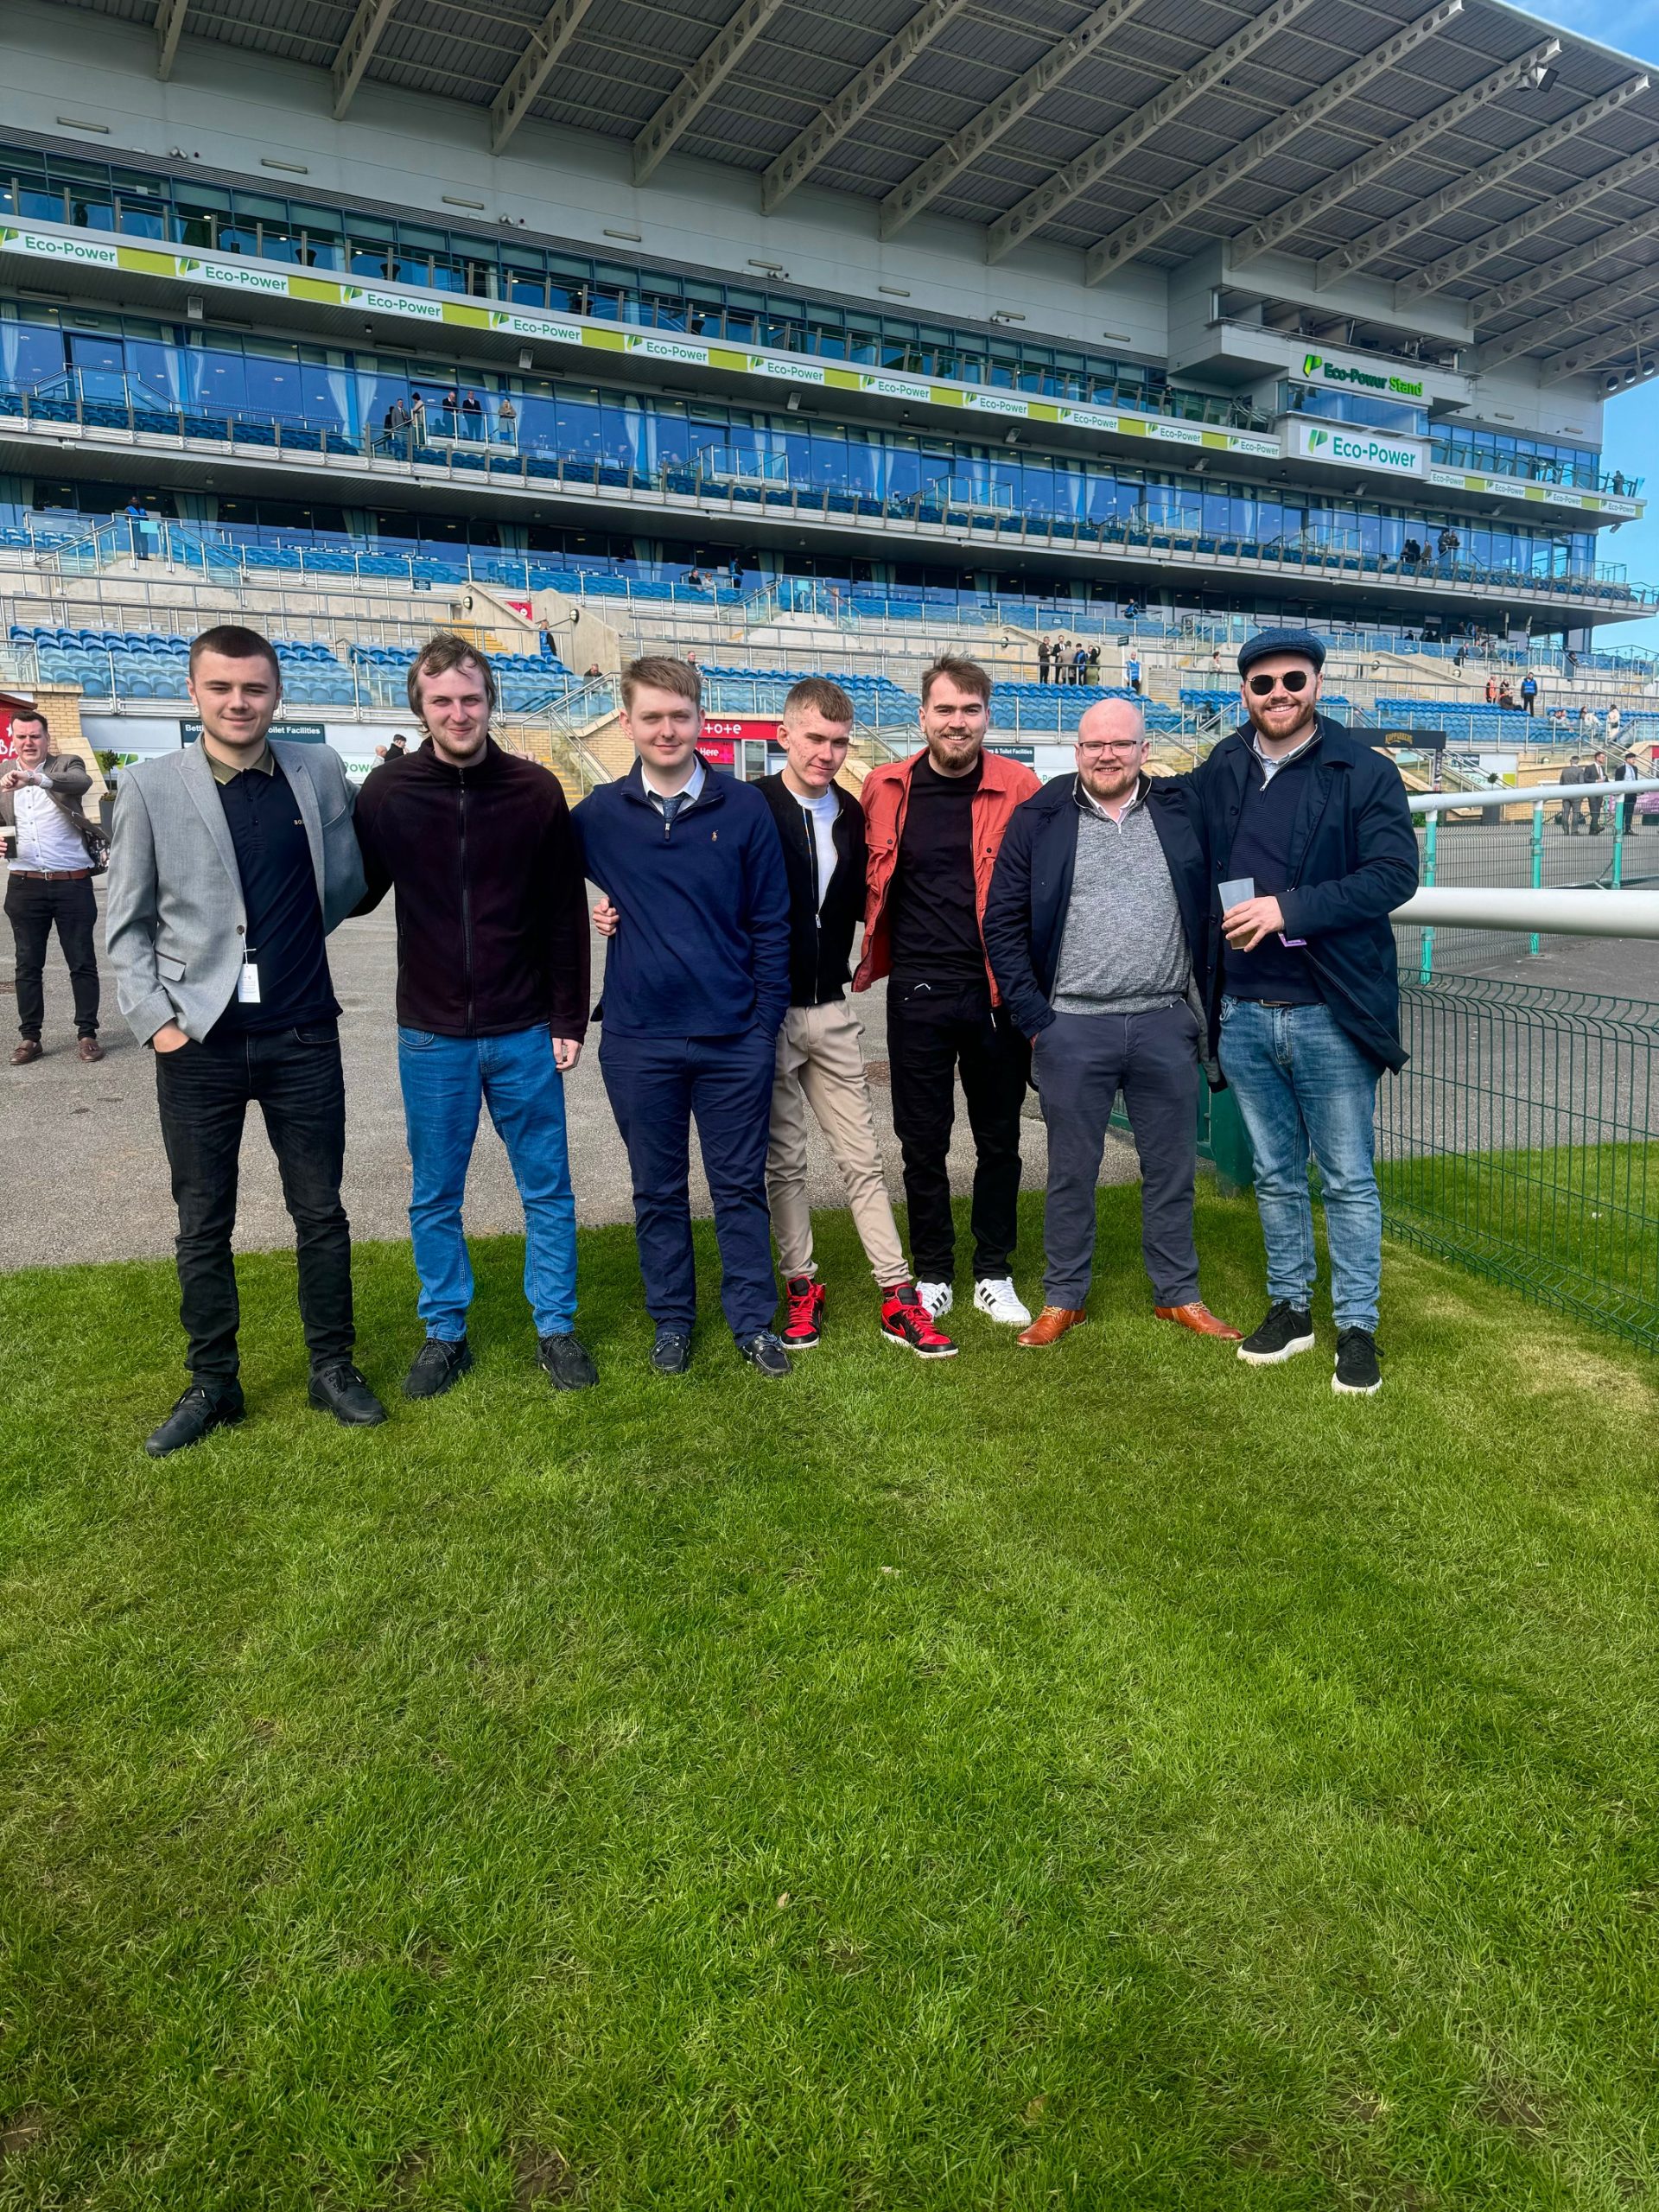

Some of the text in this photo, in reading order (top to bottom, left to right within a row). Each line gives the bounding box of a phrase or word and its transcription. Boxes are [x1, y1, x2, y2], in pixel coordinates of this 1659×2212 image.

[25, 235, 116, 263] Eco-Power
[206, 265, 288, 291] Eco-Power
[367, 293, 442, 317] Eco-Power
[513, 319, 582, 340] Eco-Power
[645, 341, 708, 361] Eco-Power
[766, 361, 823, 381] Eco-Power
[1324, 362, 1423, 397] Eco-Power Stand
[878, 380, 930, 399] Eco-Power
[979, 397, 1027, 415] Eco-Power
[1072, 412, 1117, 429] Eco-Power
[1160, 428, 1201, 442] Eco-Power
[1241, 441, 1280, 455] Eco-Power
[1333, 435, 1416, 467] Eco-Power
[1433, 474, 1465, 486] Eco-Power
[1494, 483, 1525, 496] Eco-Power
[1553, 493, 1582, 505] Eco-Power
[1608, 503, 1636, 514] Eco-Power
[700, 747, 719, 756] Here
